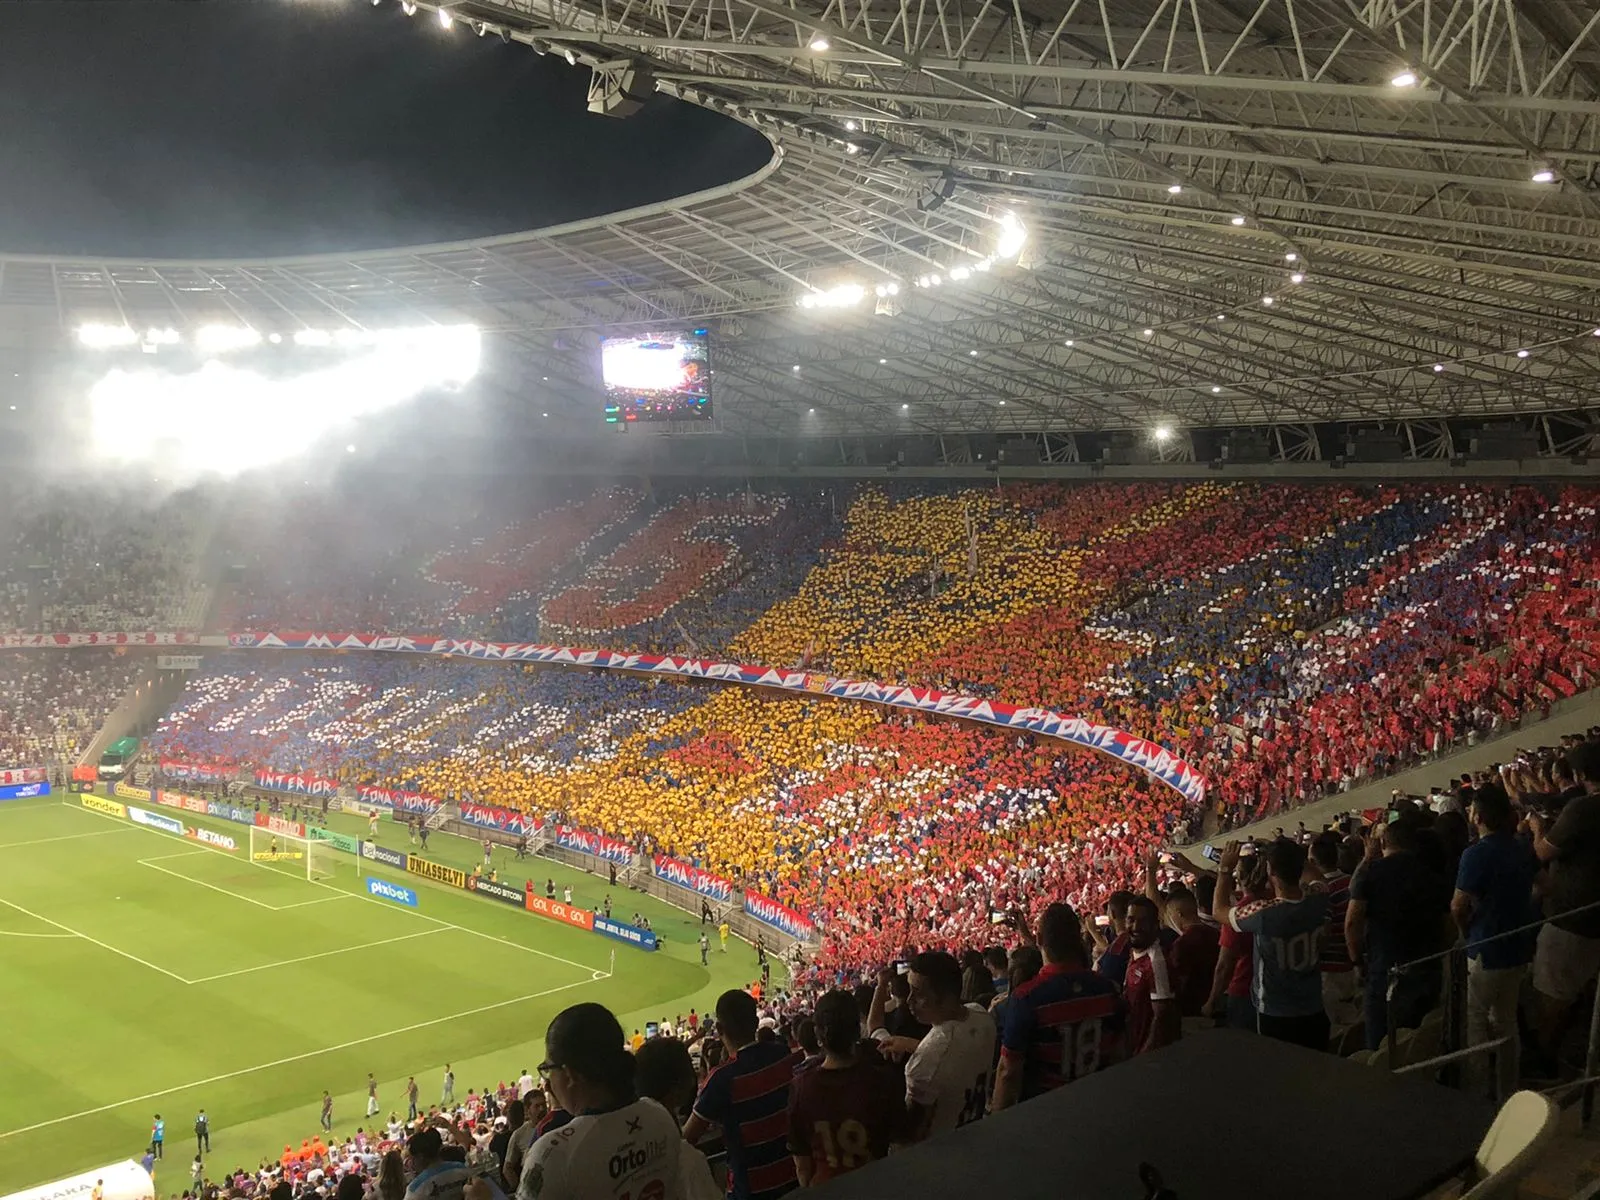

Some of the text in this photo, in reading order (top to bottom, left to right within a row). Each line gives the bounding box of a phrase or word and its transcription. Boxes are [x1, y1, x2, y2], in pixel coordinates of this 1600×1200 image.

[257, 632, 288, 648] A
[304, 632, 417, 651] MAIOR
[608, 653, 643, 669] DE
[651, 656, 744, 681] AMOR
[756, 669, 806, 688] AO
[828, 679, 996, 721] FORTALEZA
[1008, 706, 1120, 748] ESPORTE
[1121, 739, 1180, 779] CLUBE
[259, 772, 332, 797] INTERIOR
[83, 796, 120, 816] vonder
[360, 787, 393, 805] ZONA
[403, 794, 437, 813] NORTE
[268, 816, 301, 836] BETANO
[463, 806, 496, 826] ZONA
[197, 828, 235, 849] BETANO
[558, 832, 633, 865] ZONA LESTE
[409, 856, 464, 887] UNIASSELVI
[658, 857, 730, 899] ZONA OESTE
[370, 881, 410, 903] pixbet
[476, 881, 523, 902] MERCADO BITCOIN
[532, 898, 586, 924] GOL GOL GOL
